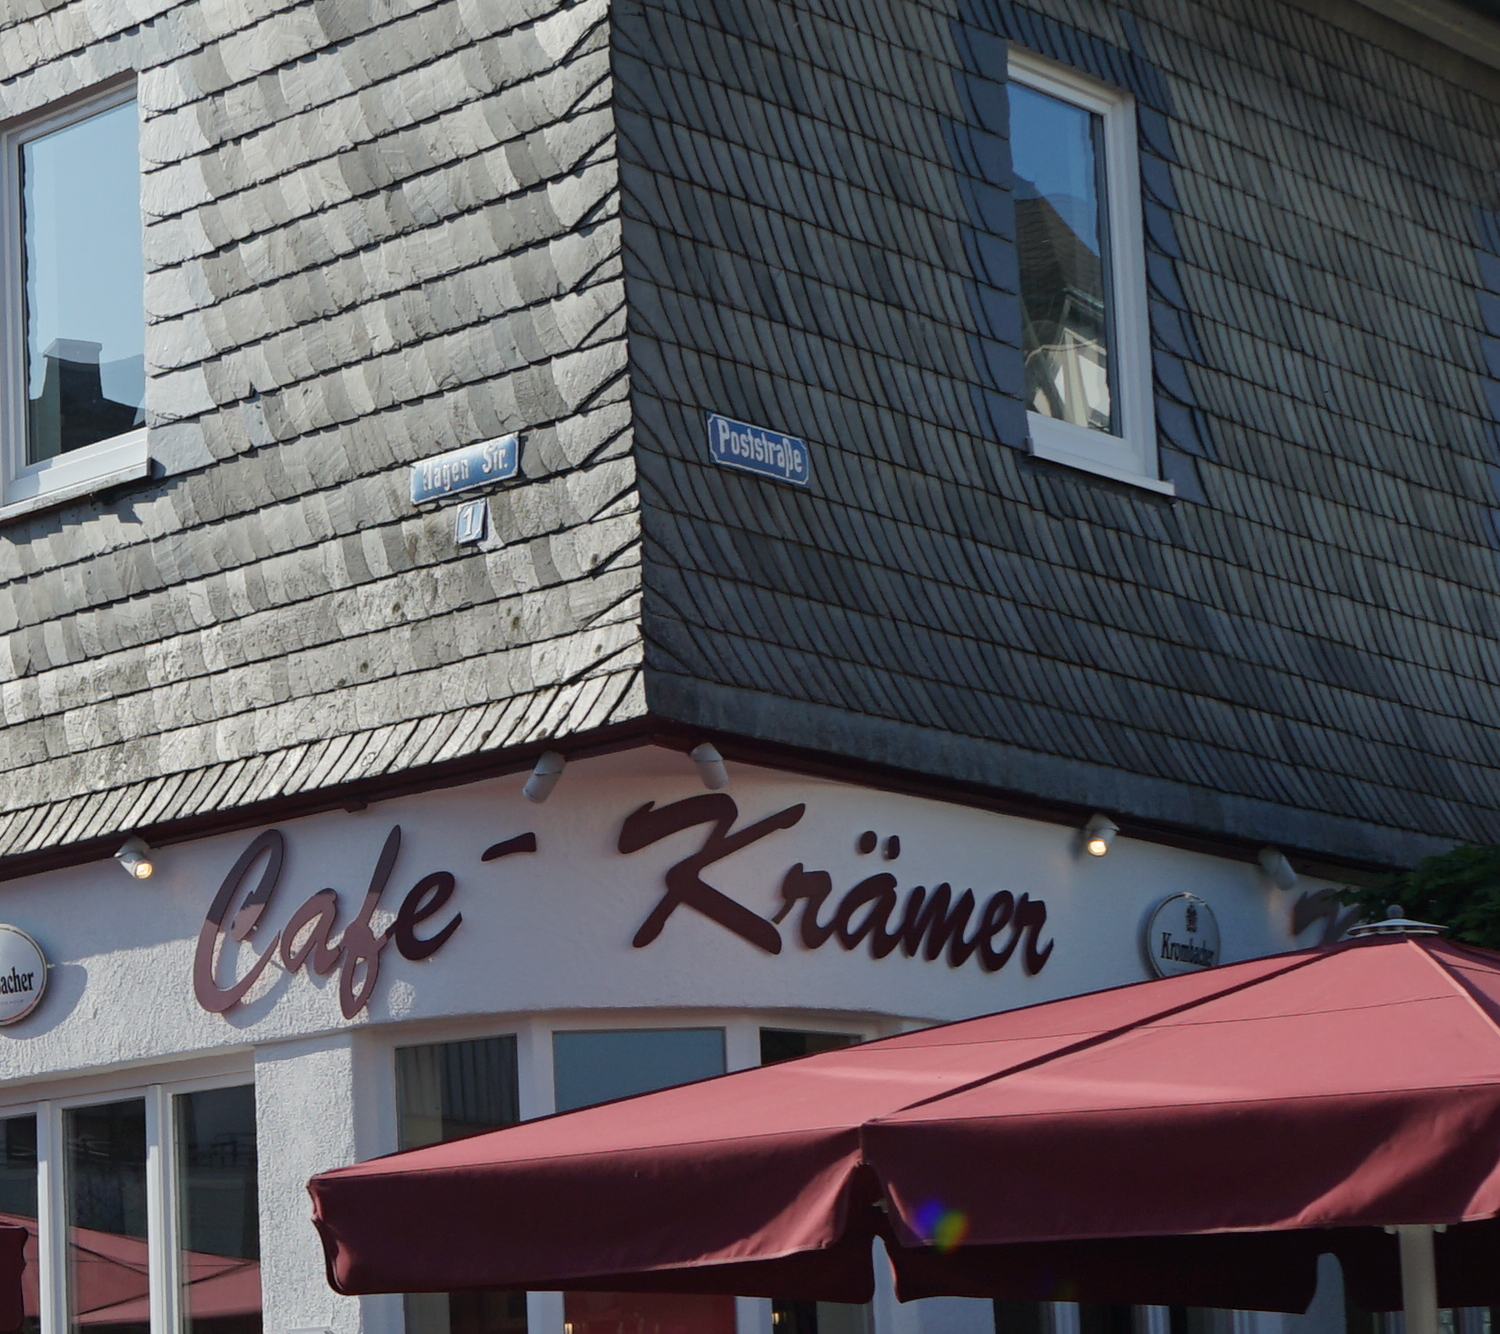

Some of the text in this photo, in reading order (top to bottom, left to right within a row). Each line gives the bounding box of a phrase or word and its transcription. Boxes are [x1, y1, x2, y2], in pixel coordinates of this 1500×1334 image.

[422, 444, 508, 492] Hagen Str.
[717, 419, 803, 478] Poststraße
[462, 505, 475, 536] 1
[193, 793, 1055, 1020] Café Krämer
